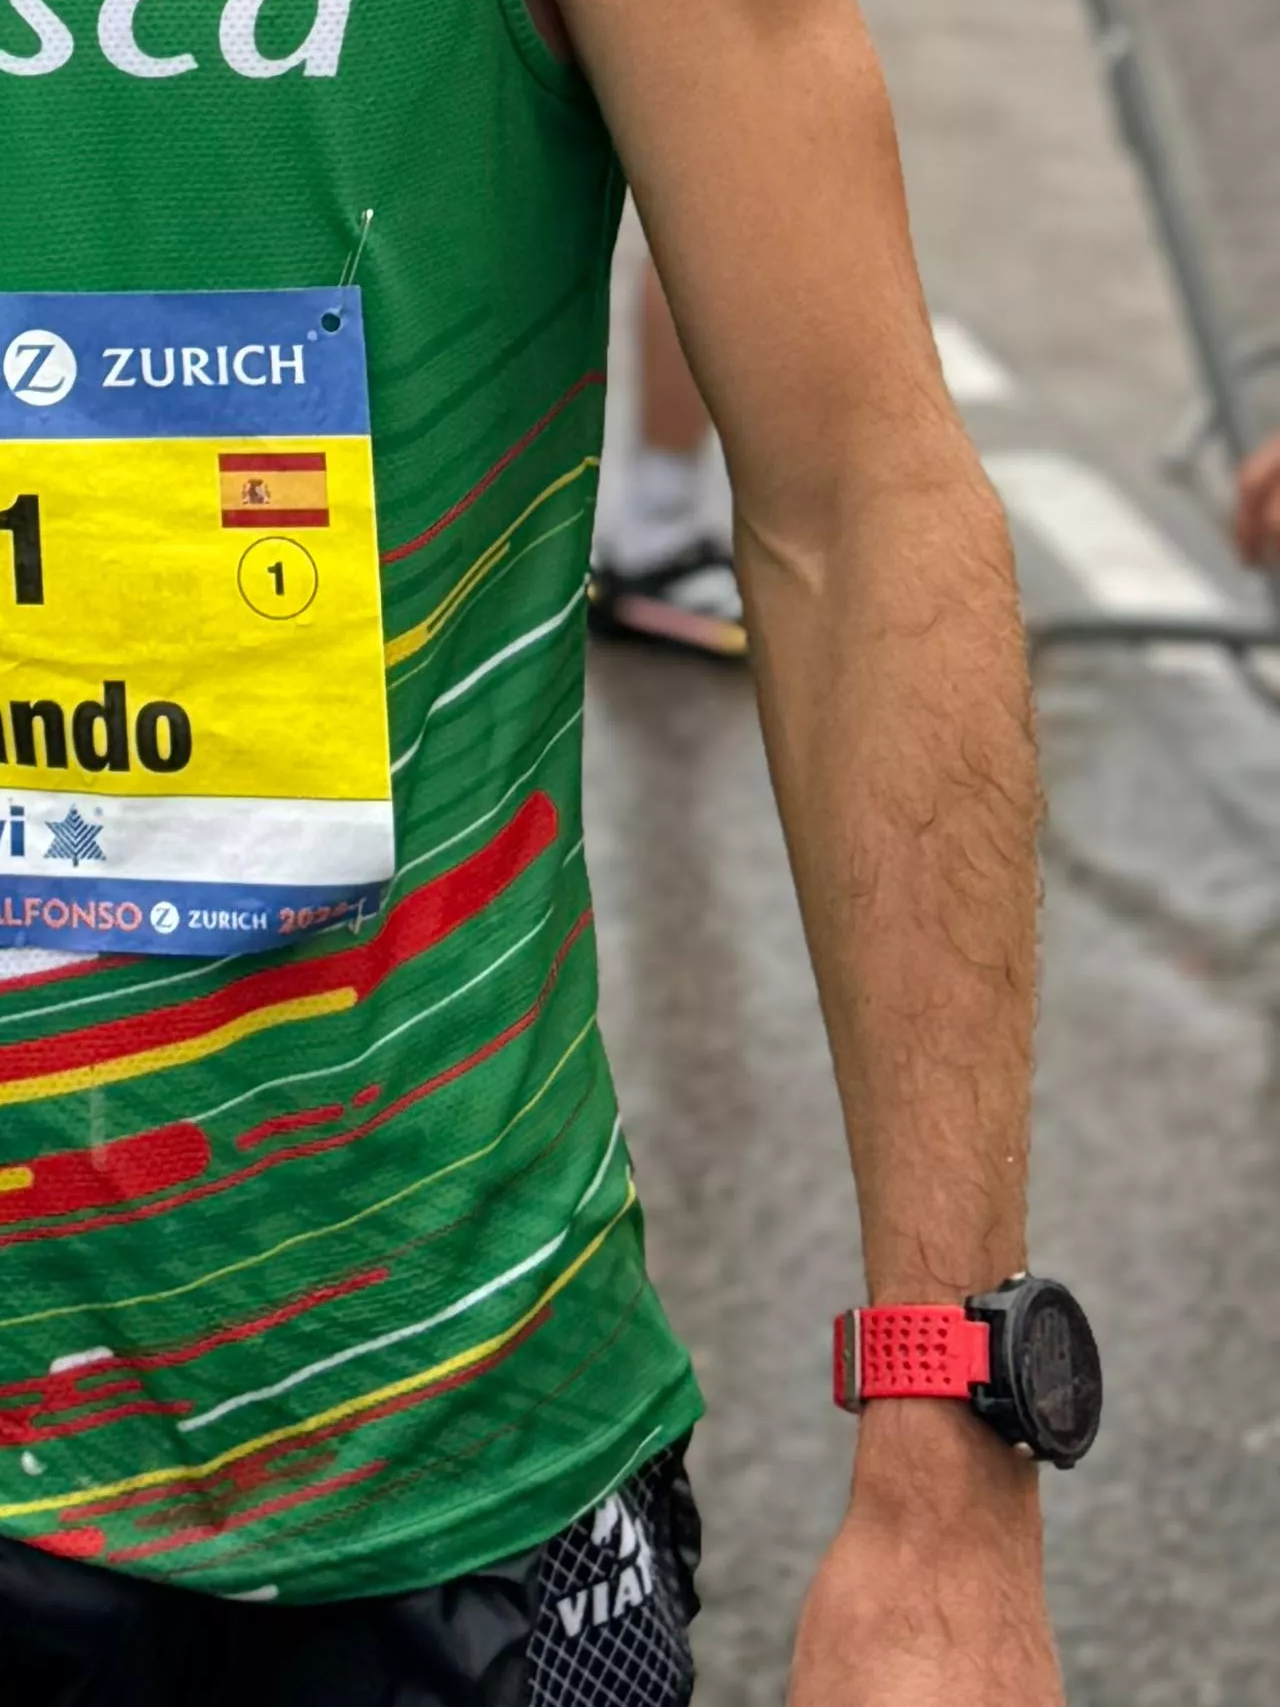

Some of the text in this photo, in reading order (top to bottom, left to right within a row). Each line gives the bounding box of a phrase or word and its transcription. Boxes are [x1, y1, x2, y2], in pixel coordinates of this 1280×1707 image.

[102, 344, 305, 388] ZURICH
[266, 562, 286, 596] 1
[188, 910, 267, 931] ZURICH
